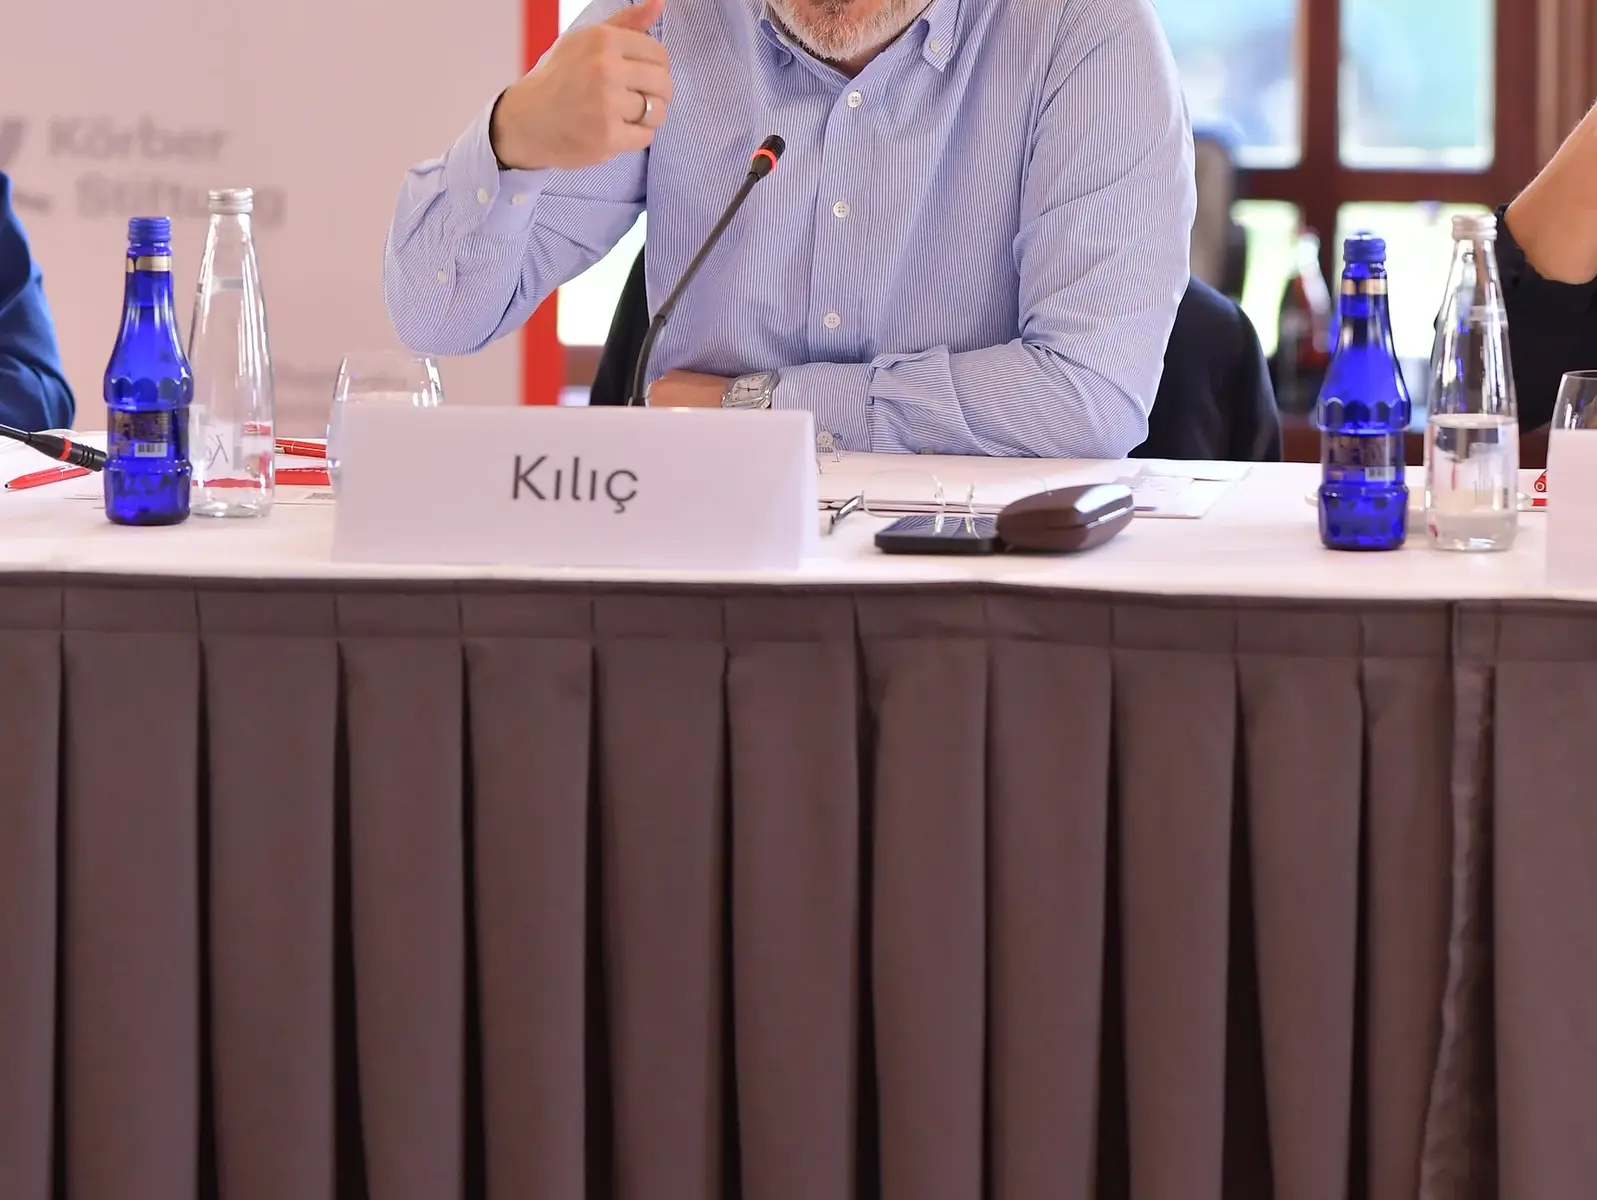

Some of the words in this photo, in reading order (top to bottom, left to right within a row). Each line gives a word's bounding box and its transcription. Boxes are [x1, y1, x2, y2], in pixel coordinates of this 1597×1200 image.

[48, 115, 227, 161] Körber
[75, 171, 286, 230] Stiftug
[512, 455, 638, 514] Kılıç
